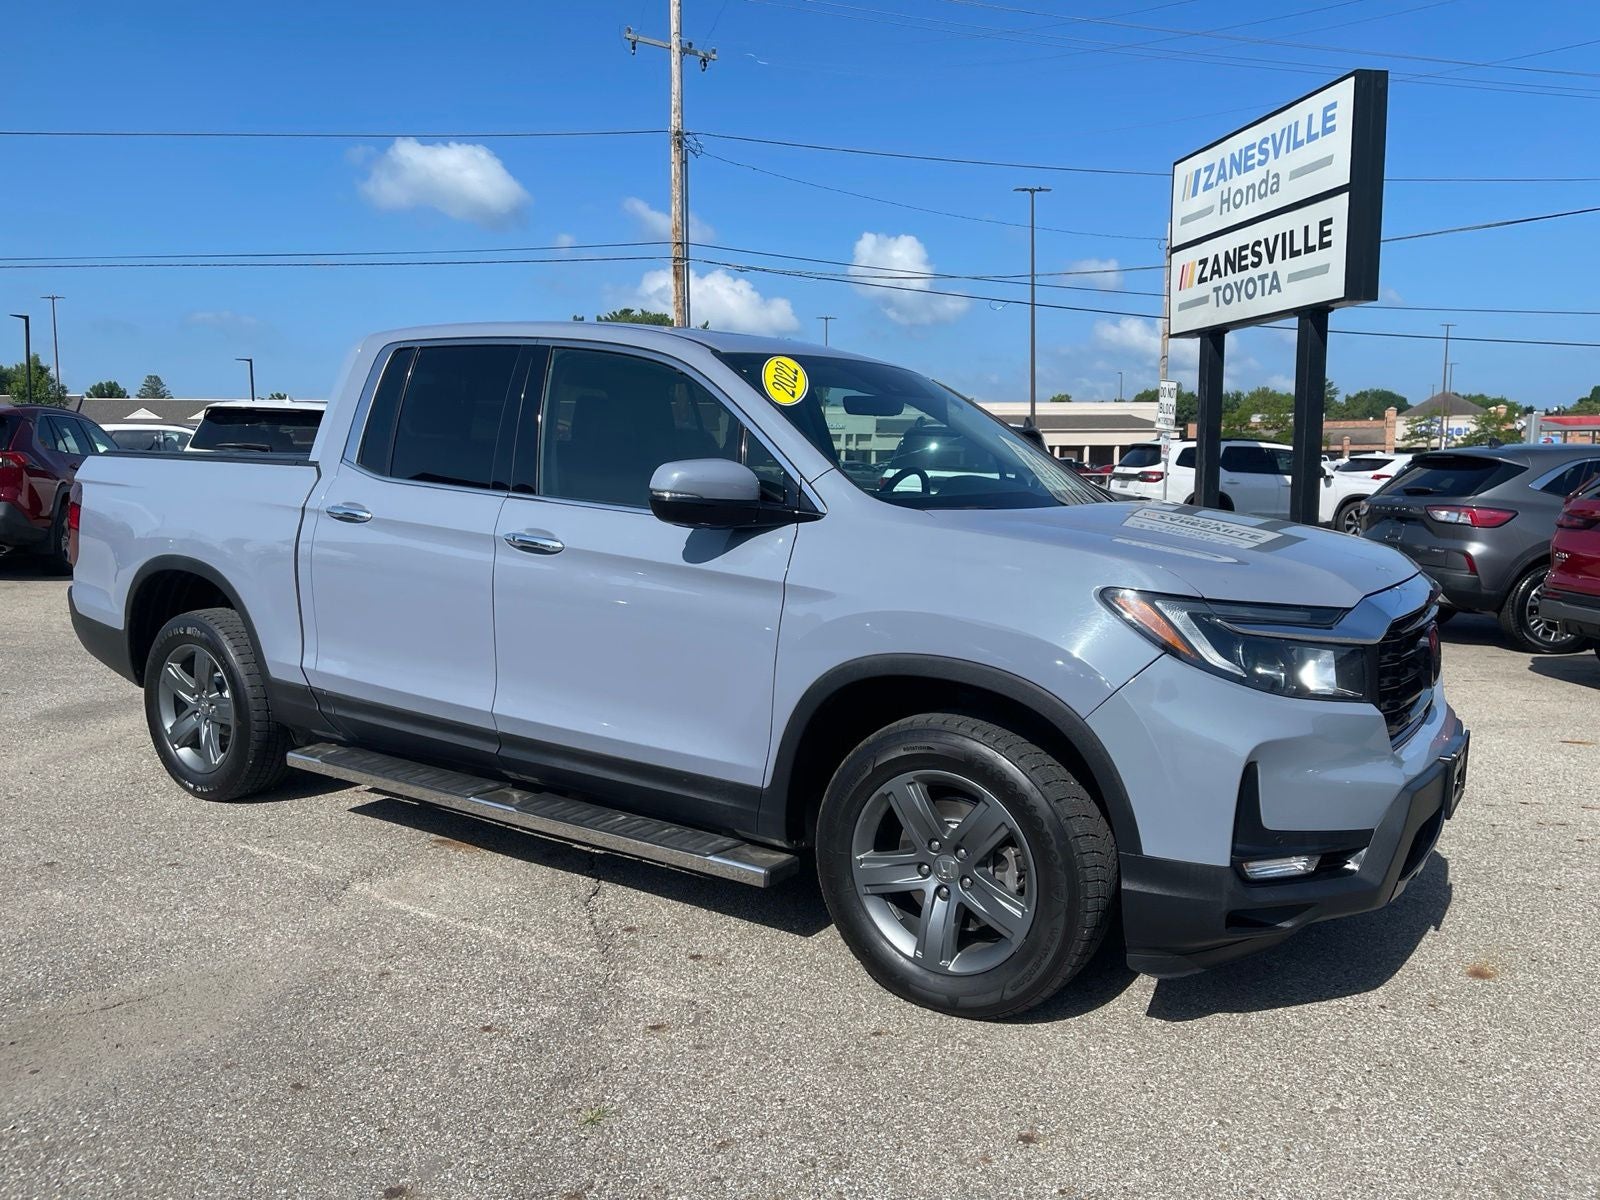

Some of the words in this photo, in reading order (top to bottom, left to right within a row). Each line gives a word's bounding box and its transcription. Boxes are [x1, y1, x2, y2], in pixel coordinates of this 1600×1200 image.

[1202, 101, 1338, 192] ZANESVILLE
[1219, 167, 1281, 216] Honda
[1197, 217, 1334, 284] ZANESVILLE
[1212, 270, 1282, 308] TOYOTA
[772, 360, 798, 398] 2022
[1160, 387, 1167, 398] DO
[1167, 387, 1176, 399] NOT
[1159, 402, 1176, 415] BLOCK
